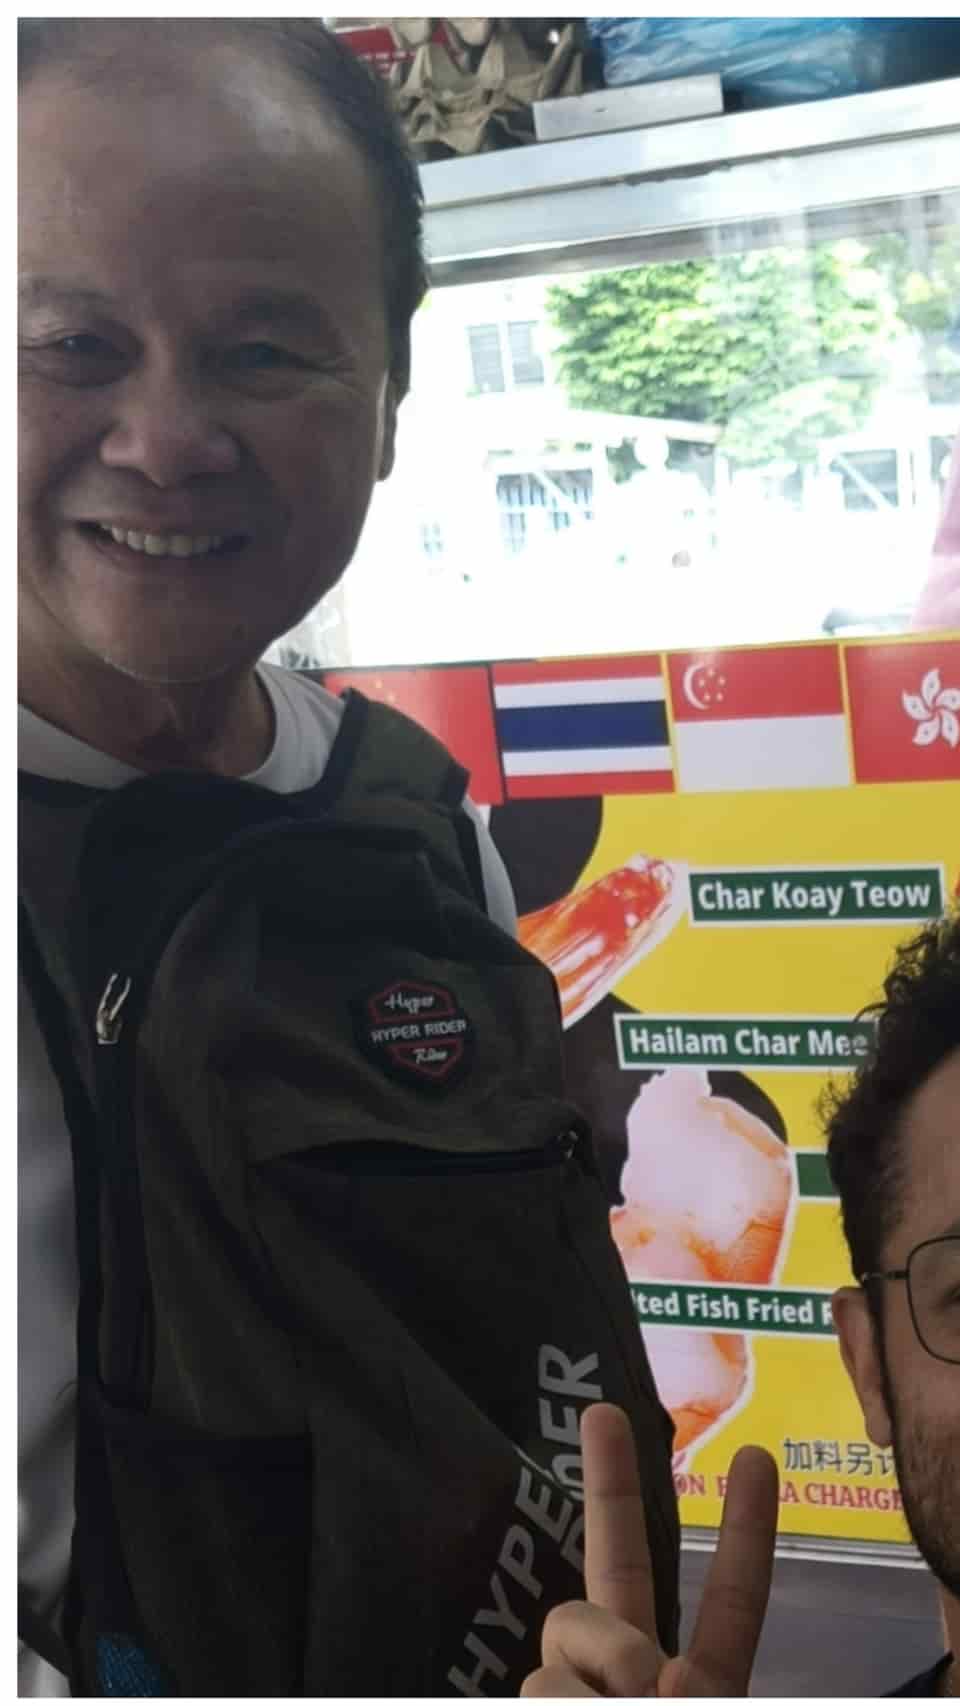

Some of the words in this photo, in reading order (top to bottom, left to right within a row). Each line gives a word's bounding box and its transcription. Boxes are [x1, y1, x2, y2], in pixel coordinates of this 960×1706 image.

[698, 881, 766, 912] Char
[771, 879, 843, 916] Koay
[848, 879, 932, 909] Teow
[370, 1024, 422, 1044] HYPER
[423, 1018, 467, 1036] RIDER
[629, 1025, 728, 1058] Hailam
[734, 1025, 803, 1057] Char
[685, 1293, 740, 1321] Fish
[746, 1297, 814, 1326] Fried
